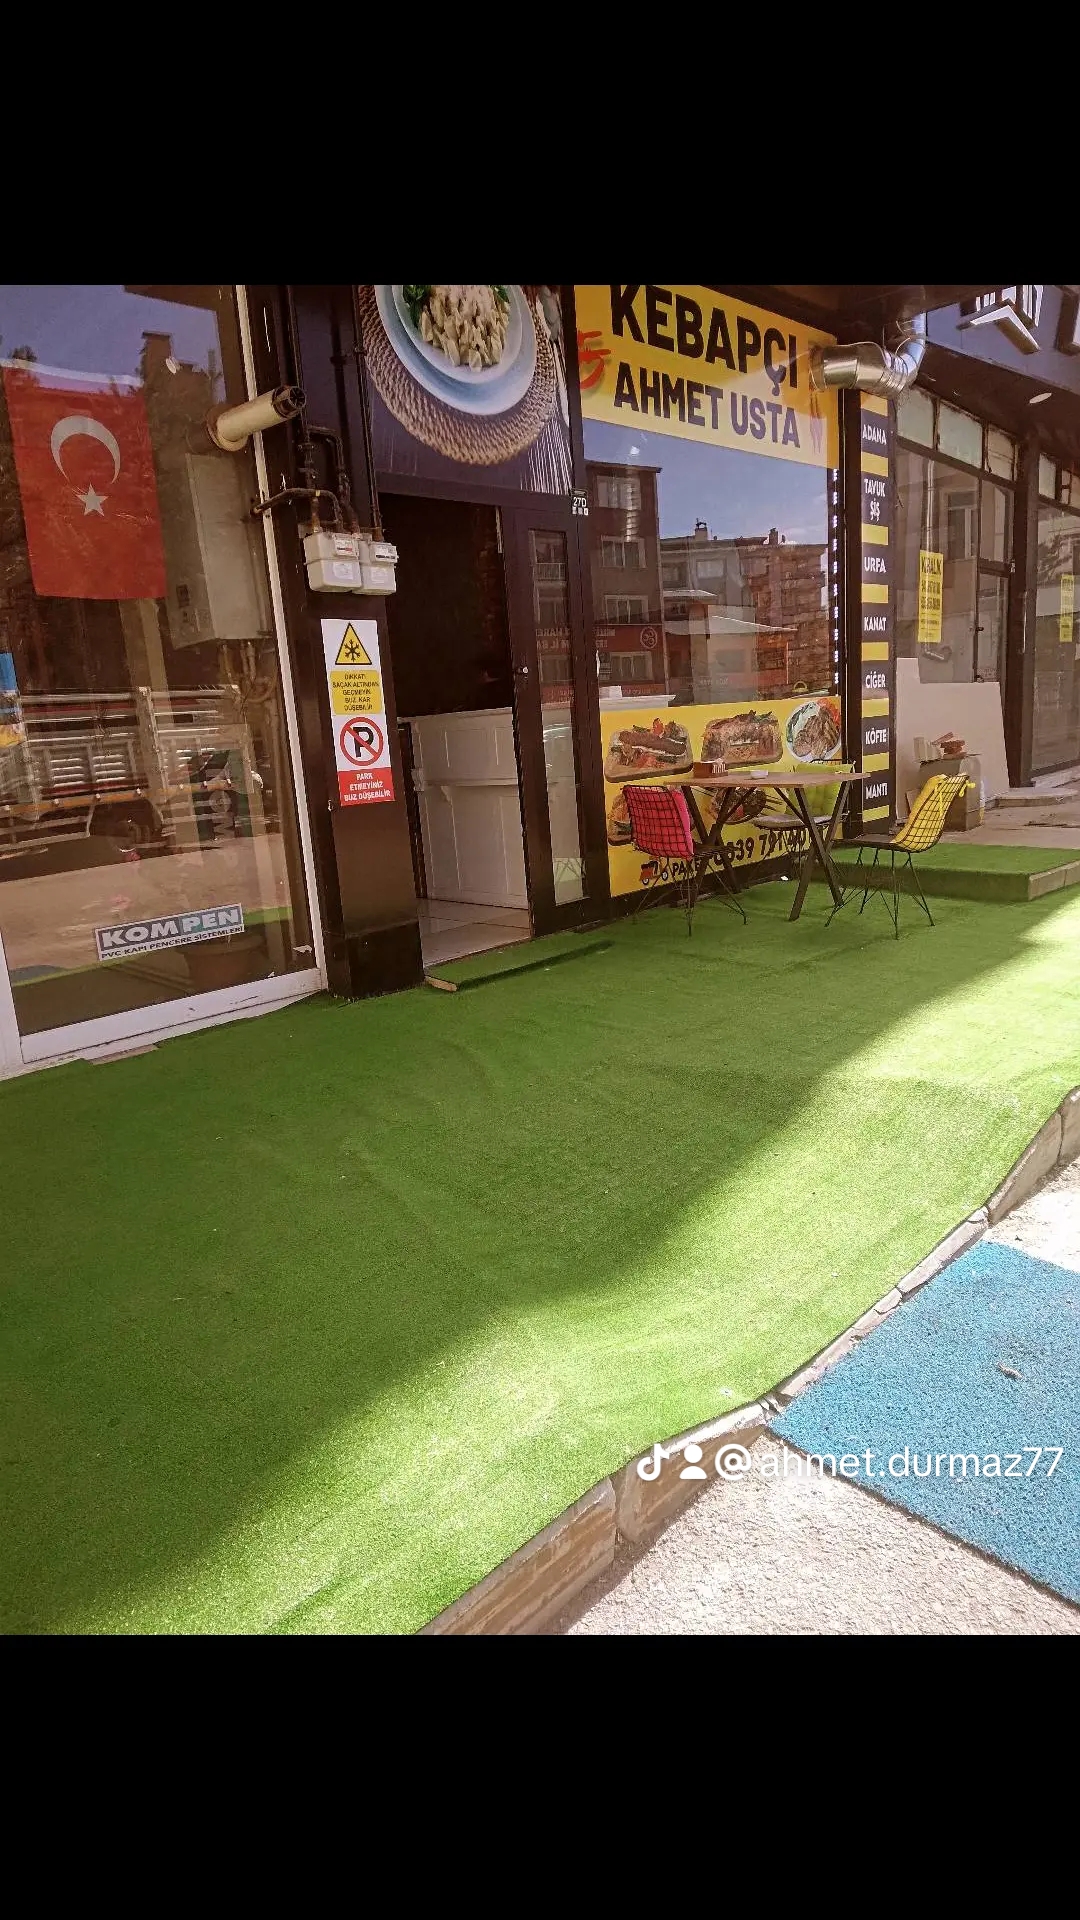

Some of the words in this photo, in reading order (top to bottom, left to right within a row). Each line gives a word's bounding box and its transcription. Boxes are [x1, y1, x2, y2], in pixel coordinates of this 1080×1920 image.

[610, 285, 798, 396] KEBAPÇI
[614, 361, 724, 429] AHMET
[730, 391, 801, 448] USTA
[862, 424, 887, 445] ADANA
[864, 478, 886, 497] TAVUK
[870, 497, 881, 522] ŞİŞ
[864, 556, 887, 574] URFA
[864, 616, 887, 632] KANAT
[865, 671, 886, 689] CİĞER
[865, 727, 887, 745] KÖFTE
[349, 780, 384, 791] ETMEYİNİZ
[356, 772, 374, 781] PARK
[344, 793, 358, 802] BUZ
[358, 789, 391, 801] DÜŞEBİLİR
[865, 782, 888, 799] MANTI
[102, 908, 239, 948] KOMPEN
[101, 950, 122, 959] PVC
[124, 945, 147, 954] KAPI
[149, 935, 193, 950] PENCERE
[194, 926, 243, 941] SİSTEMLERİ
